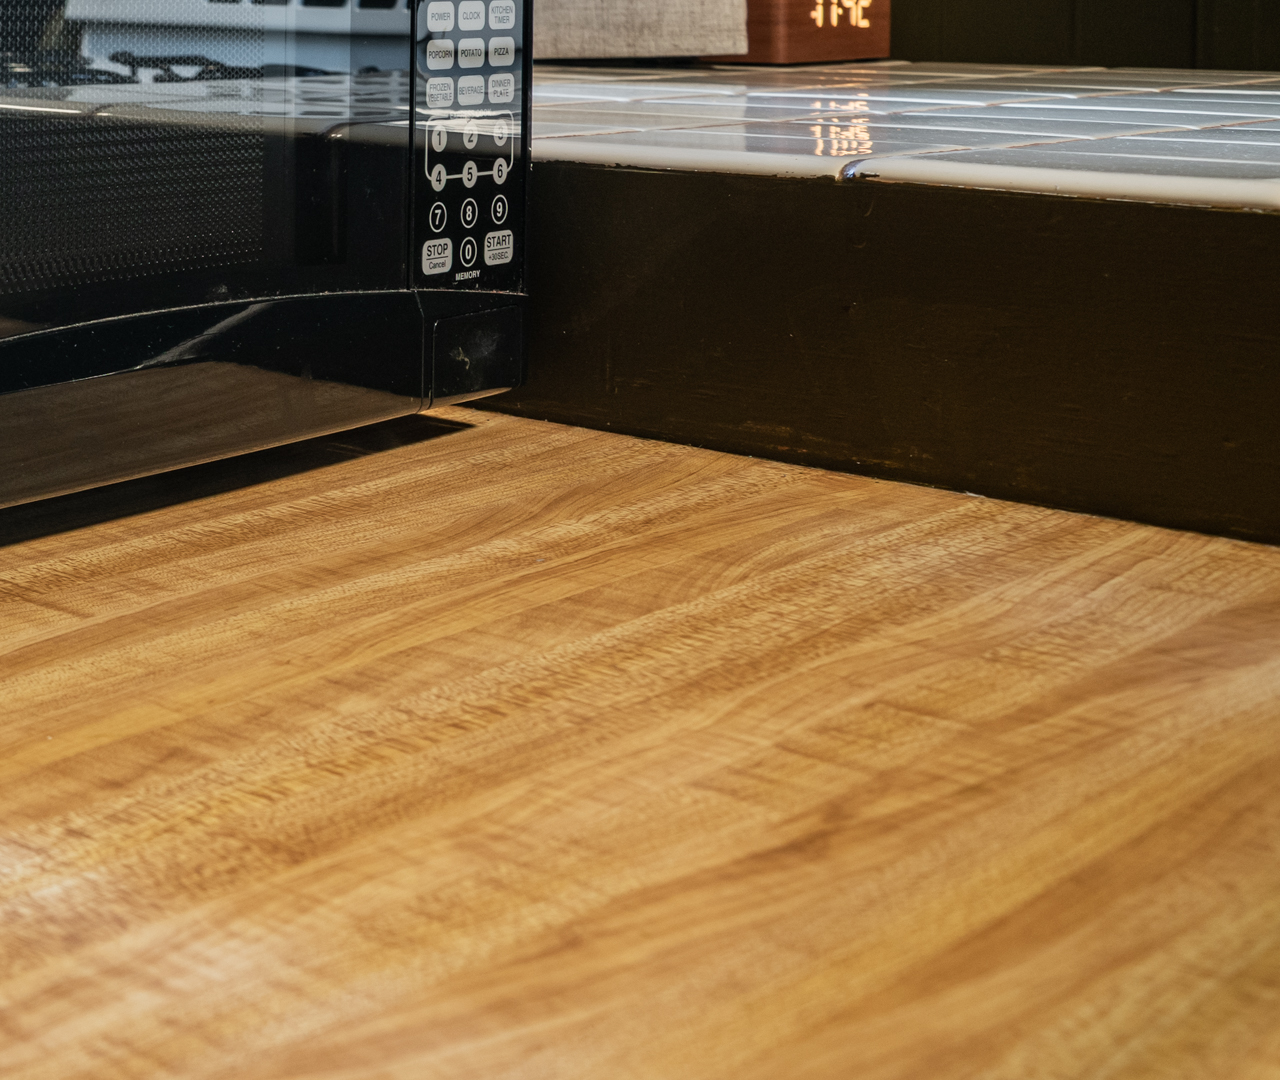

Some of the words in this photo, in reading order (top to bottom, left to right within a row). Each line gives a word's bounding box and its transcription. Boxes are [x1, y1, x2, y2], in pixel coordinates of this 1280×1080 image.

[491, 5, 513, 14] KITCHEN
[431, 12, 451, 21] POWER
[462, 11, 481, 20] CLOCK
[494, 15, 510, 24] TIMER
[429, 50, 452, 59] POPCORN
[460, 48, 482, 58] POTATO
[493, 47, 509, 56] PIZZA
[429, 82, 451, 92] FROZEN
[491, 78, 511, 88] DINNER
[459, 85, 484, 95] BEVERAGE
[493, 88, 509, 98] PLATE
[427, 93, 452, 102] VEGETABLE
[436, 131, 441, 146] 1
[467, 129, 473, 143] 2
[466, 166, 473, 181] 5
[497, 163, 503, 178] 6
[435, 170, 442, 185] 4
[466, 205, 472, 221] 8
[496, 201, 503, 217] 9
[434, 209, 442, 225] 7
[486, 234, 512, 248] START
[426, 243, 449, 257] STOP
[465, 244, 472, 260] 0
[488, 251, 509, 261] +30SEC.
[428, 260, 446, 270] Cancel
[455, 270, 480, 281] MEMORY
